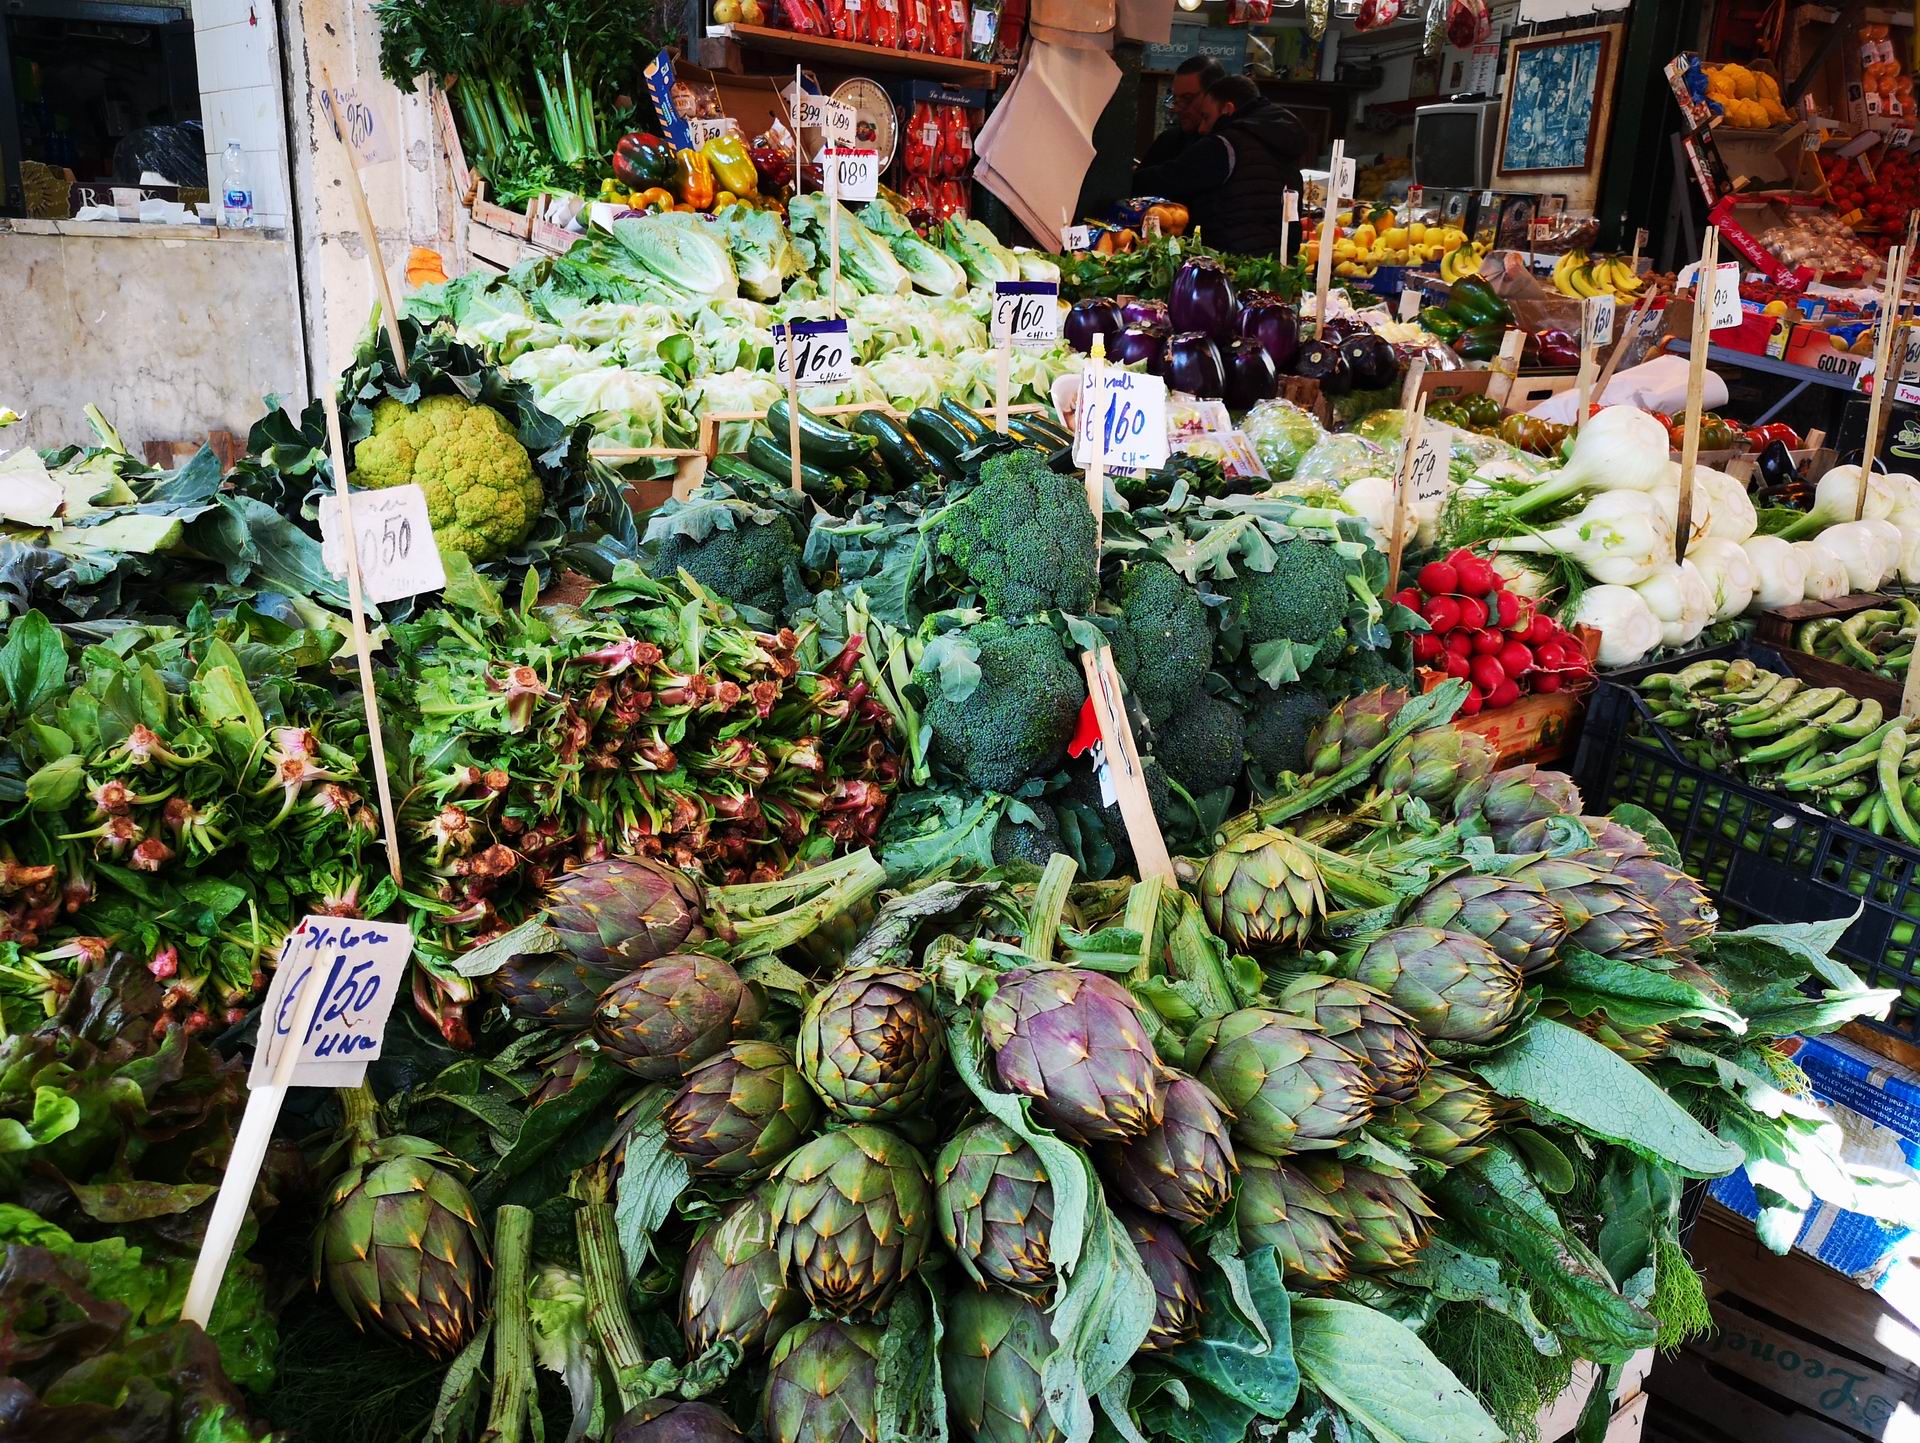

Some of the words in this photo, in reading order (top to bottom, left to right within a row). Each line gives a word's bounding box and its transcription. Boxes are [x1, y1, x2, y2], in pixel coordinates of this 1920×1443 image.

[1150, 42, 1189, 54] aparici
[1198, 45, 1236, 57] aparici
[1817, 353, 1847, 376] GOLD
[1900, 388, 1920, 404] Frag
